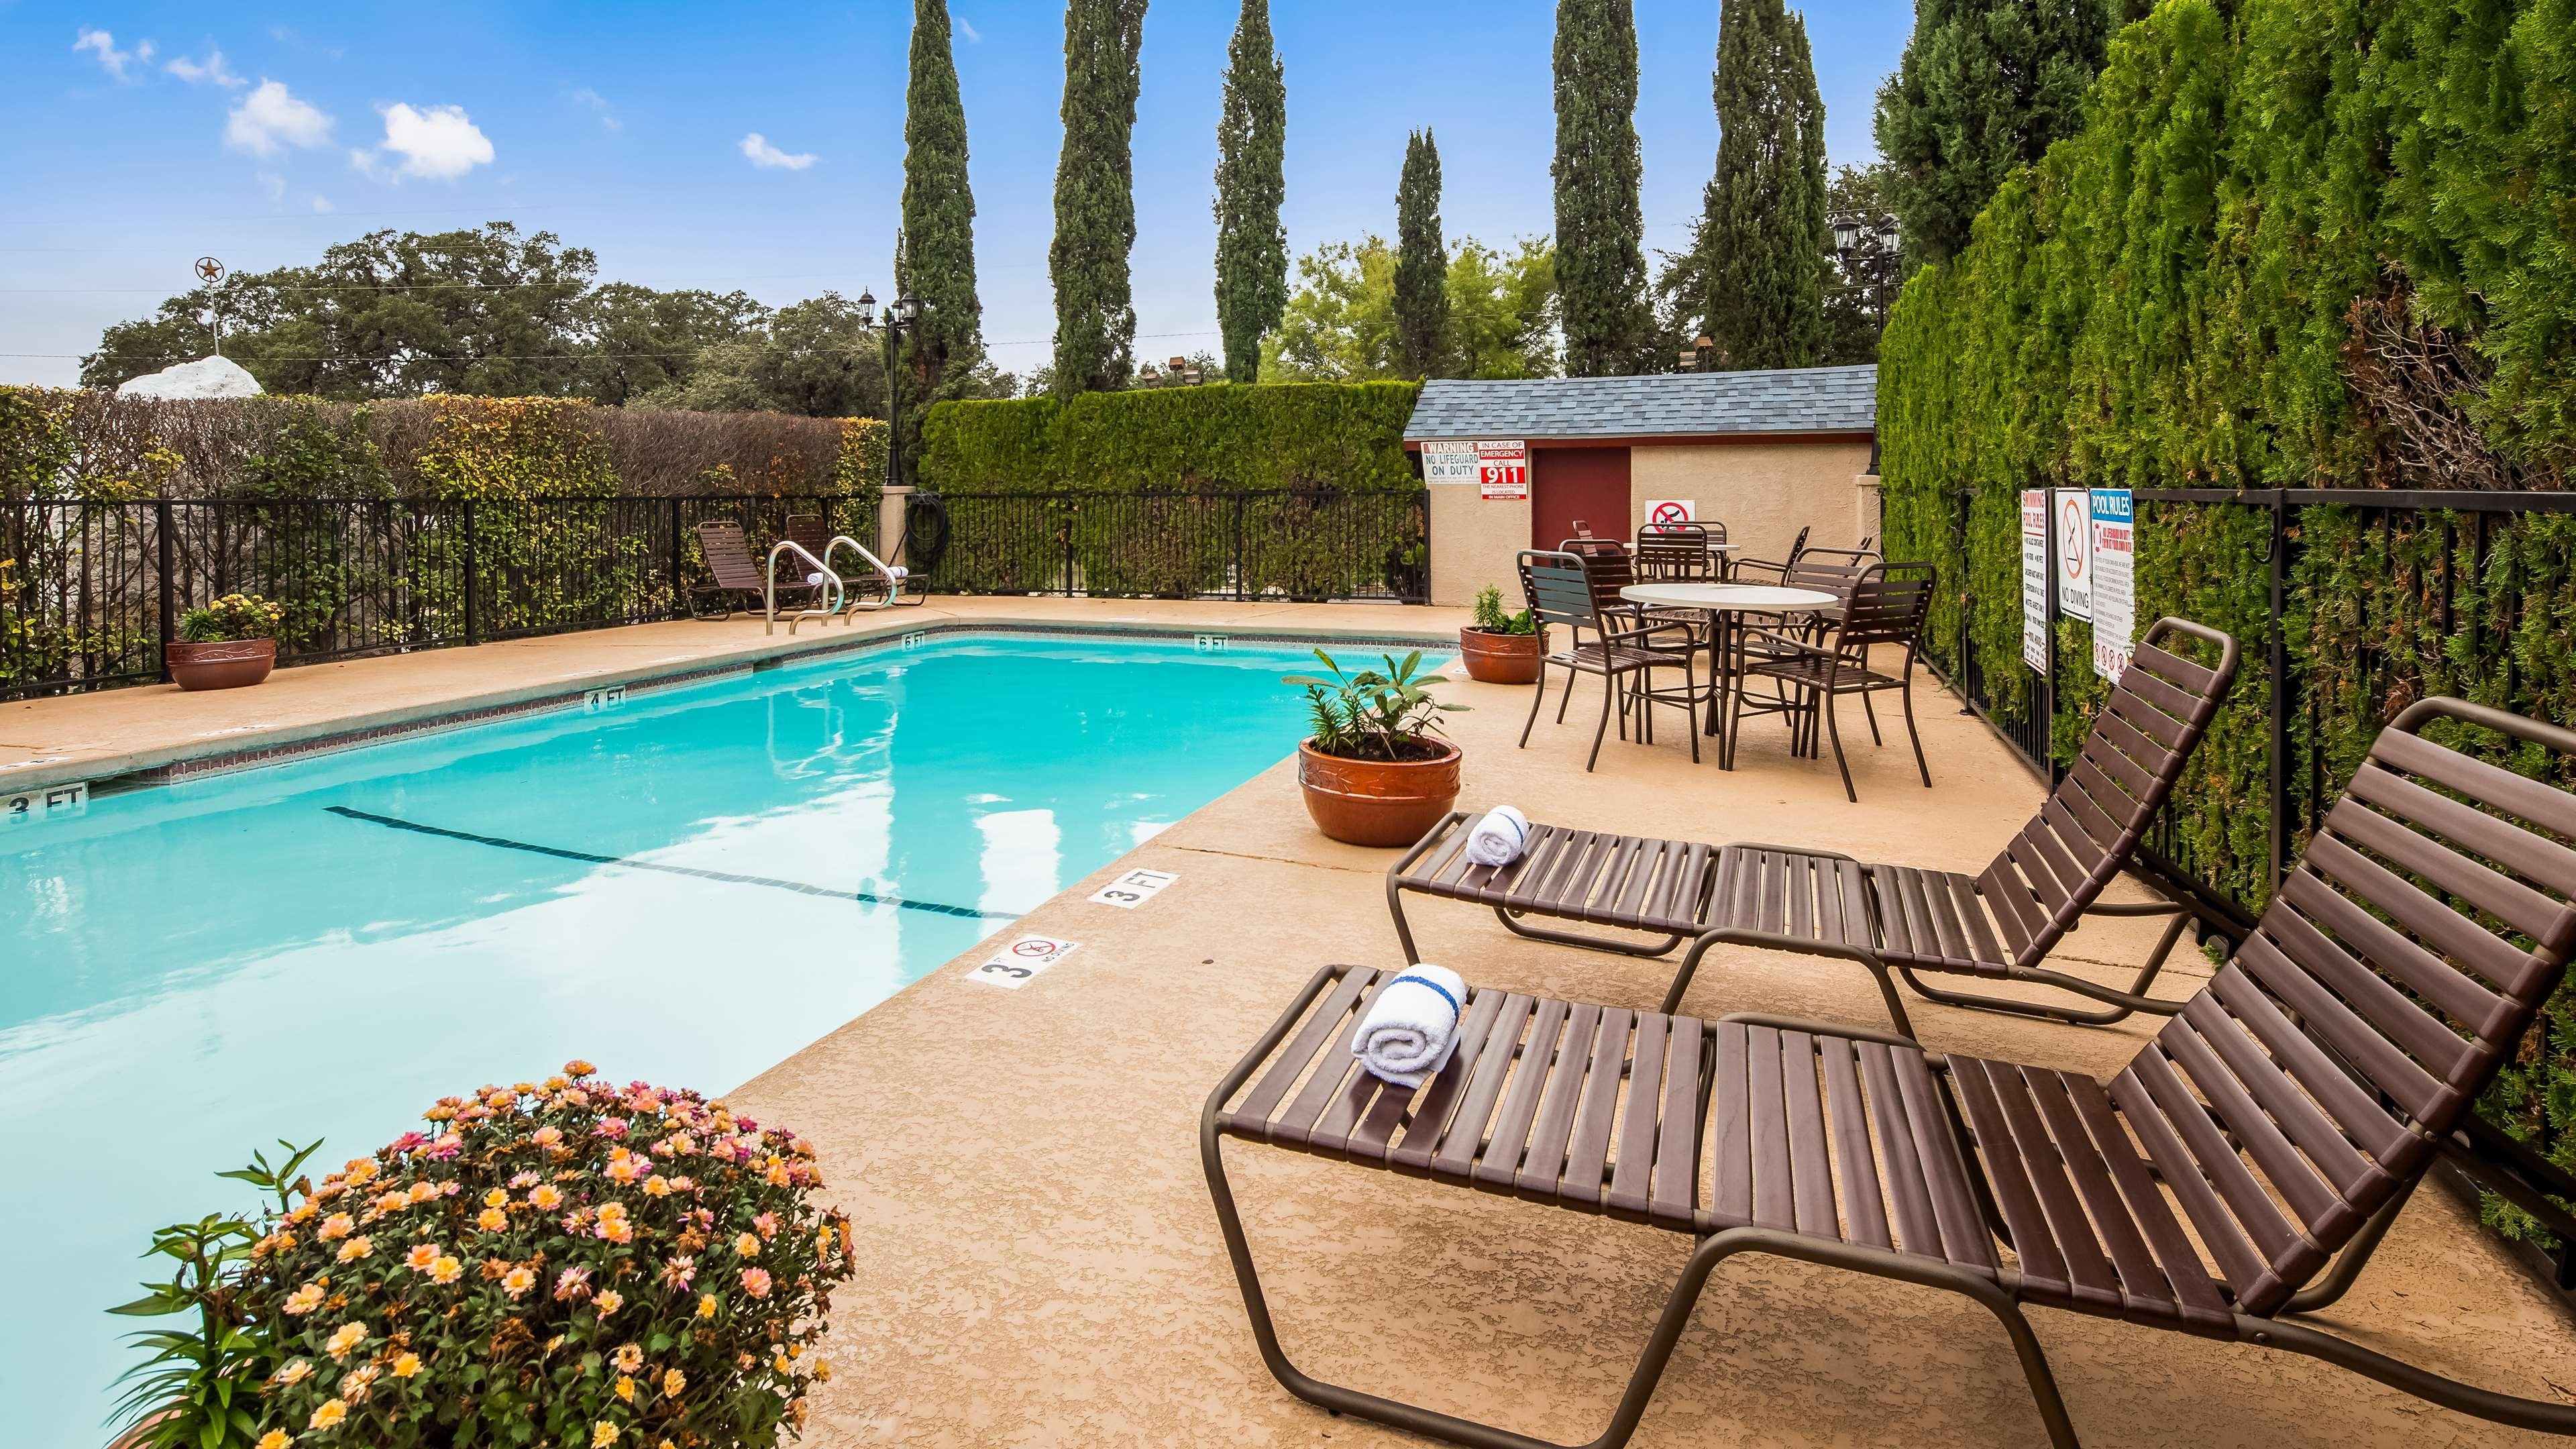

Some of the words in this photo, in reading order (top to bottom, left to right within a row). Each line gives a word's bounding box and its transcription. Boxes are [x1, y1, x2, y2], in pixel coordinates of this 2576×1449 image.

[1428, 443, 1474, 453] WARNING
[1481, 449, 1523, 458] EMERGENCY
[1426, 455, 1436, 464] NO
[1440, 454, 1479, 464] LIFEGUARD
[1432, 466, 1444, 475] ON
[1450, 466, 1474, 475] DUTY
[1487, 468, 1518, 484] 911
[2023, 492, 2045, 508] SWIMMING
[2092, 495, 2109, 515] POOL
[2109, 496, 2130, 517] RULES
[2023, 512, 2033, 527] POOL
[2033, 513, 2045, 529] RULES
[2061, 586, 2069, 602] NO
[2071, 588, 2089, 608] DIVING
[905, 636, 911, 647] 6
[914, 633, 924, 645] FT
[1199, 637, 1207, 646] 6
[1212, 637, 1226, 646] FT
[606, 688, 625, 702] FT
[46, 786, 83, 809] FT
[1104, 890, 1141, 902] 3
[1123, 871, 1169, 889] FT
[1042, 955, 1055, 963] NO
[1054, 943, 1075, 957] DIVING
[981, 964, 1032, 979] 3
